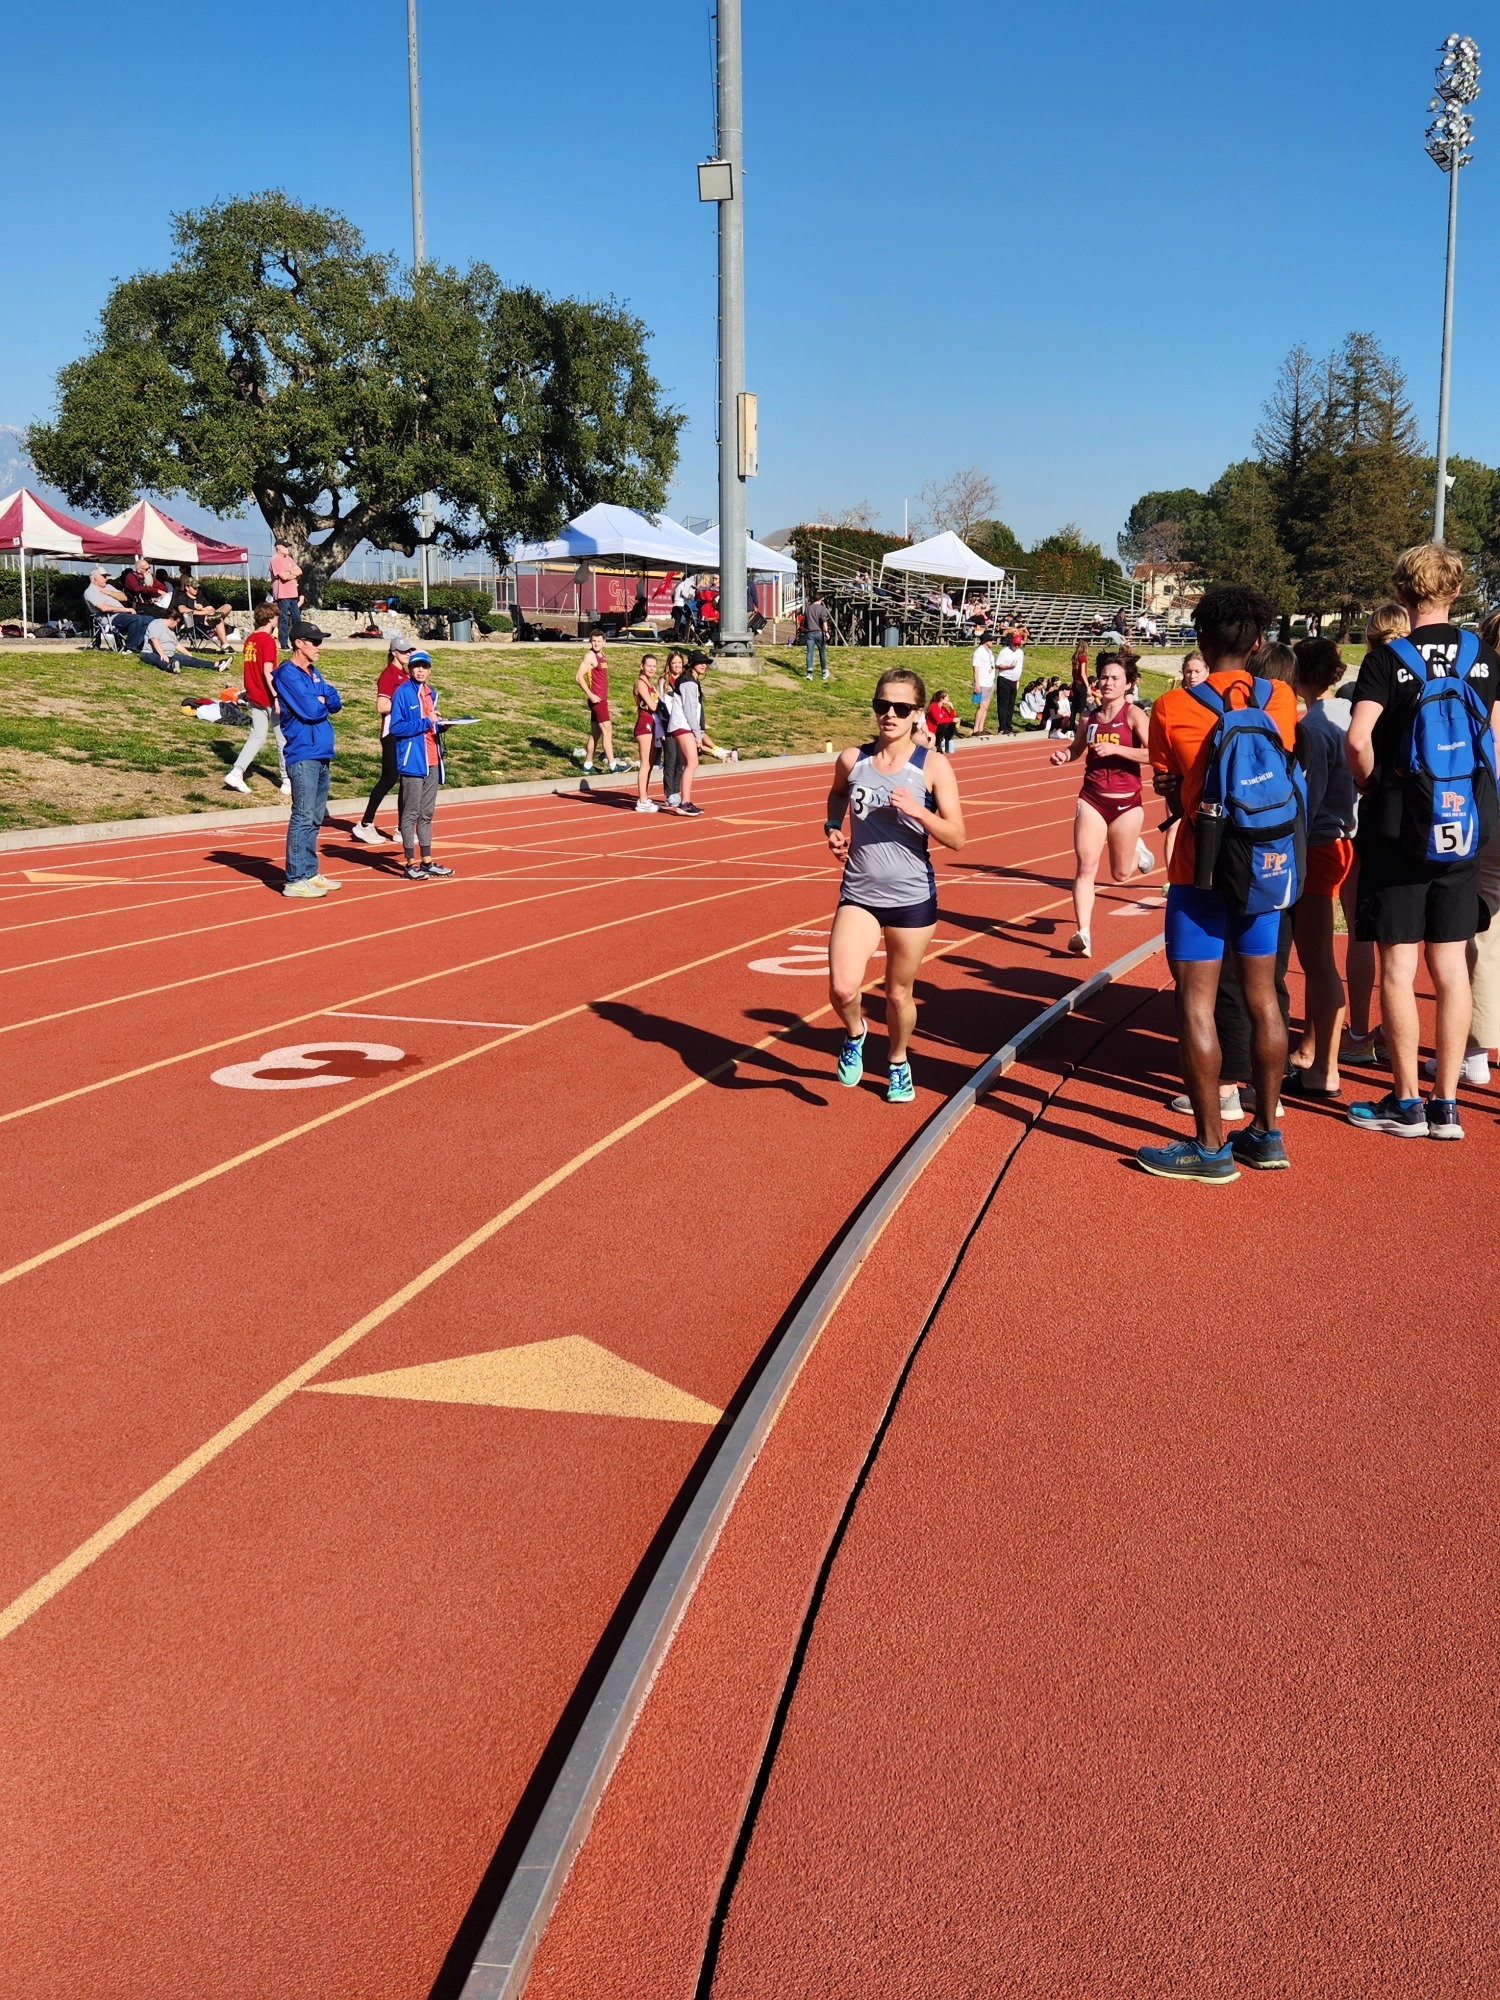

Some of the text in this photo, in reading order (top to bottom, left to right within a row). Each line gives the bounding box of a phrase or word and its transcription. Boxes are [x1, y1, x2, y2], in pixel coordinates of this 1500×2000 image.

[1091, 732, 1121, 747] MS
[853, 787, 866, 815] 3
[1441, 791, 1465, 812] PP
[1442, 825, 1457, 851] 5
[1176, 1154, 1202, 1165] HOKA
